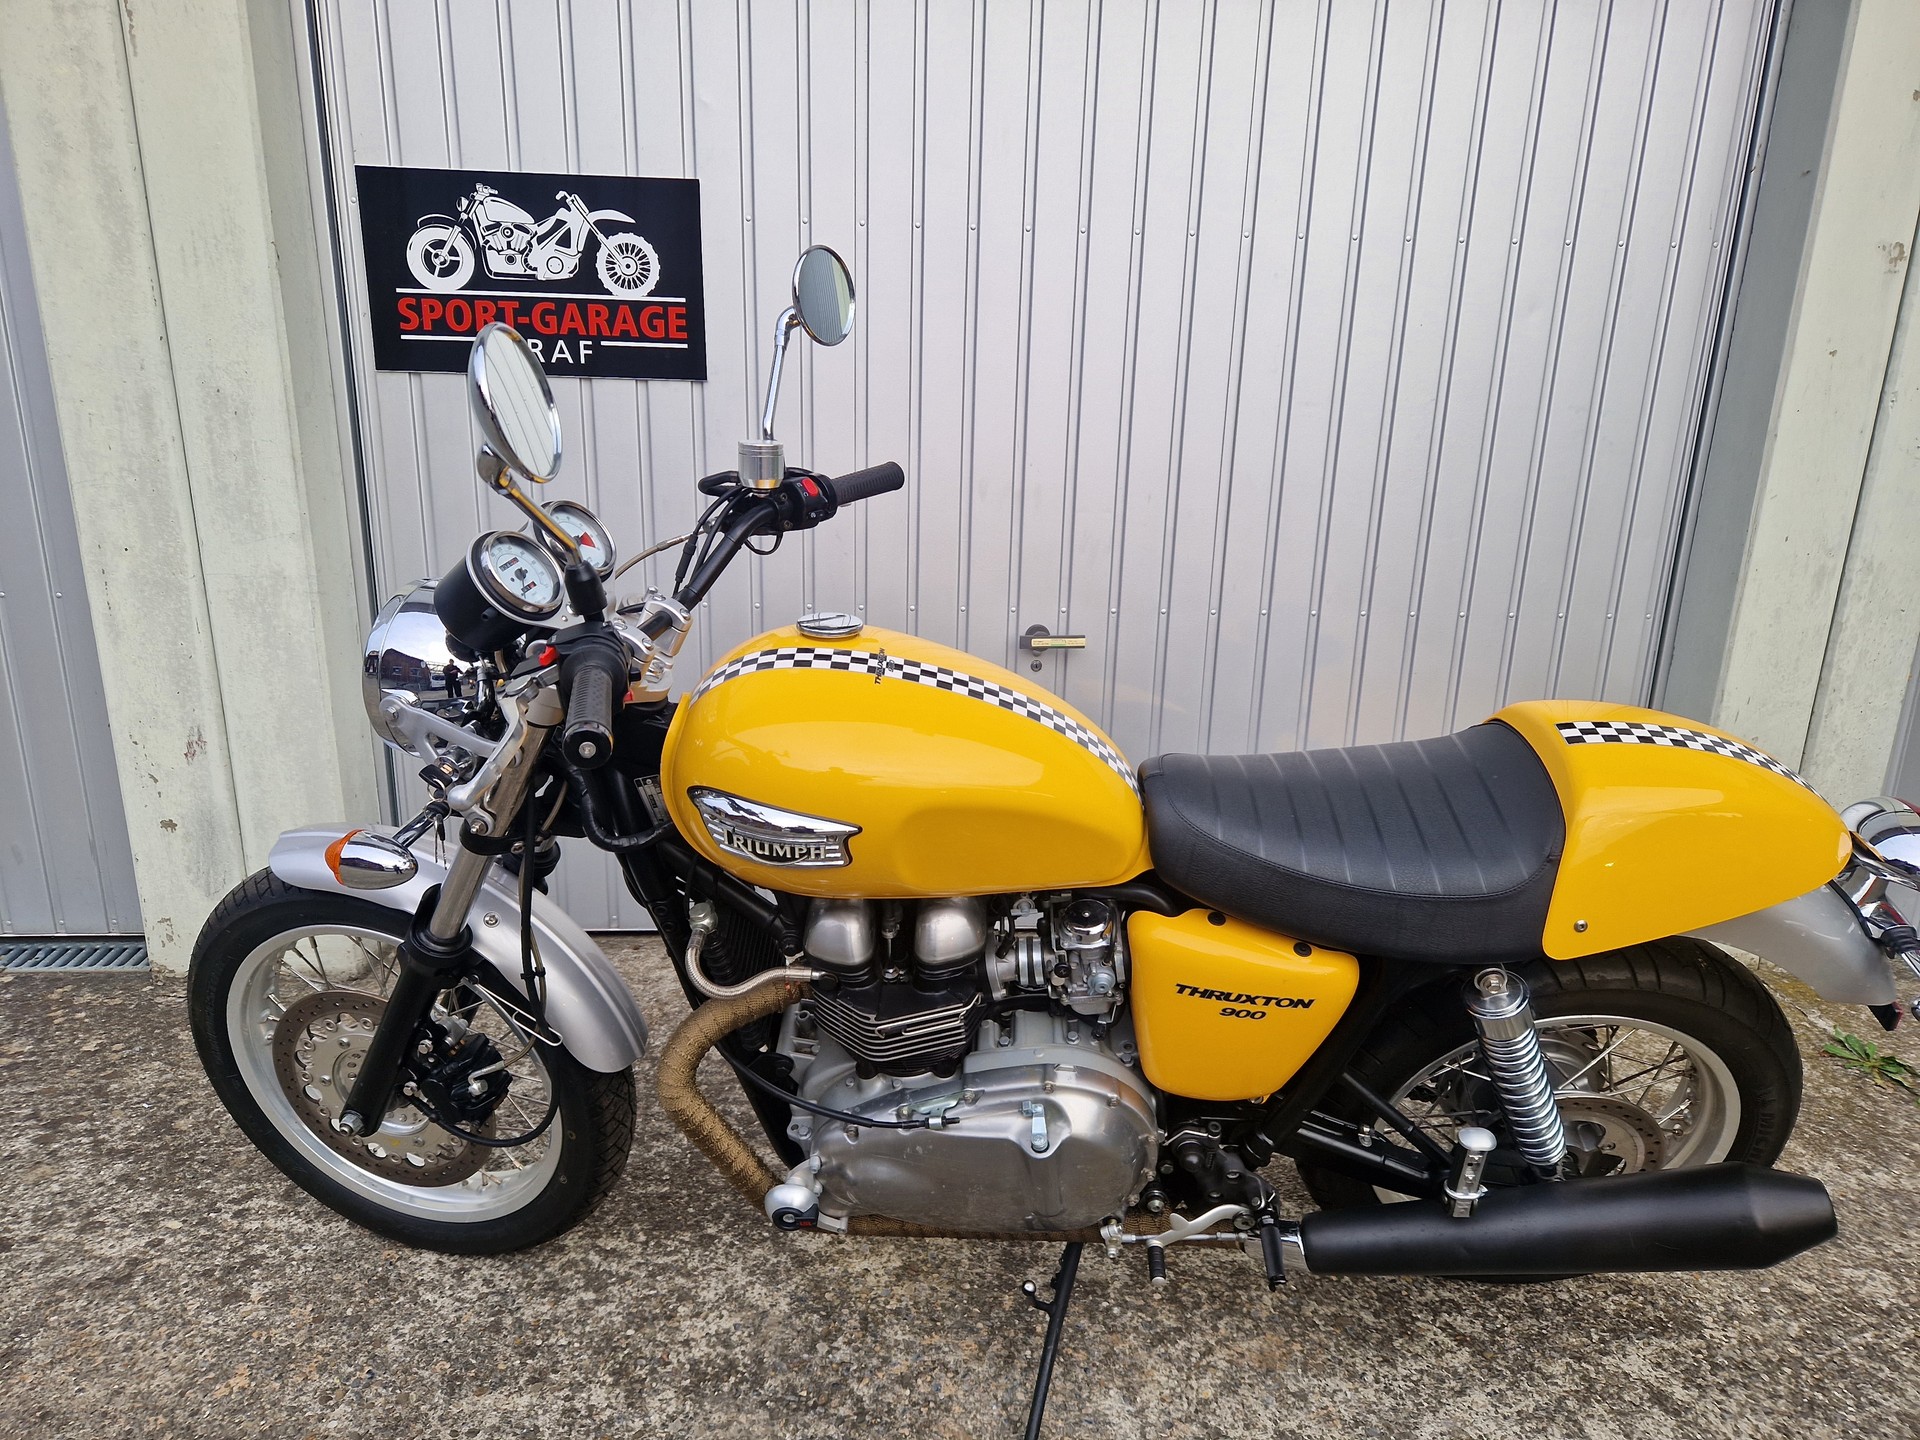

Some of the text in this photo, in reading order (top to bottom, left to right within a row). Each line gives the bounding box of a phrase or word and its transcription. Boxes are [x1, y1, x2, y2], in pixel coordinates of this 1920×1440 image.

[397, 297, 688, 339] SPORT-GARAGE
[527, 338, 593, 364] RAF
[722, 825, 827, 864] TRIUMPH
[1175, 983, 1316, 1009] THRUXTON
[1219, 1007, 1267, 1020] 900
